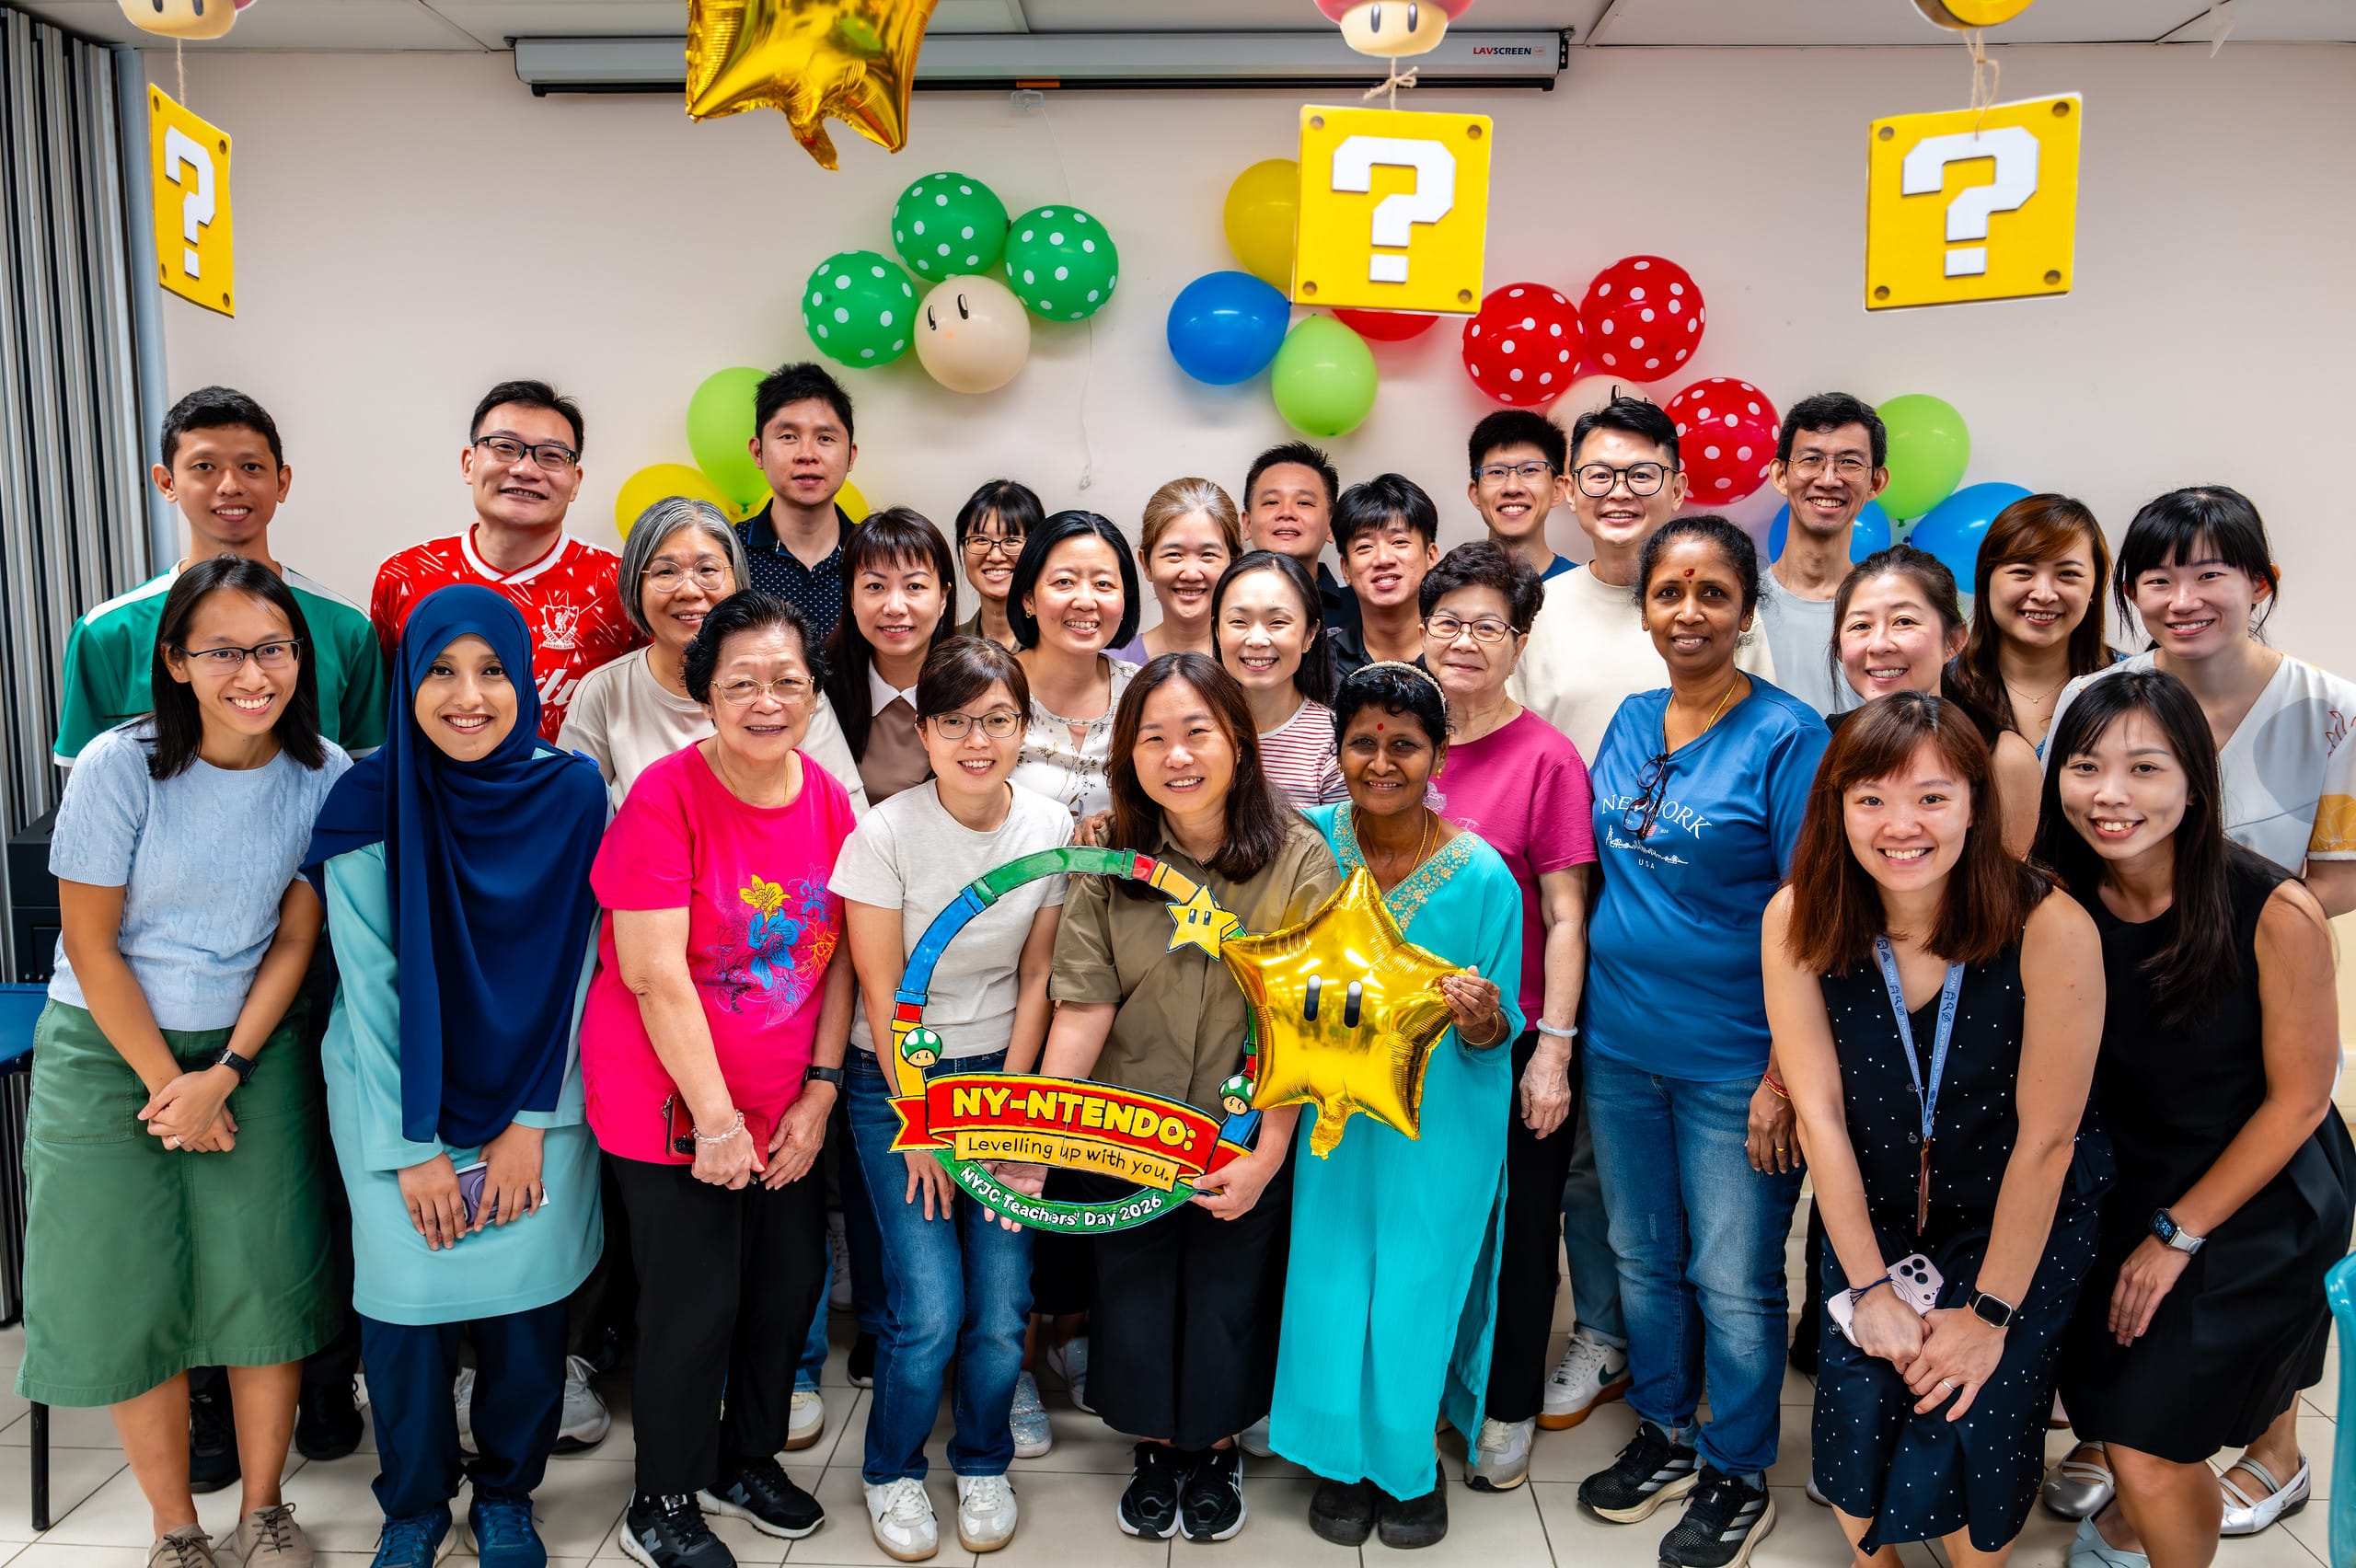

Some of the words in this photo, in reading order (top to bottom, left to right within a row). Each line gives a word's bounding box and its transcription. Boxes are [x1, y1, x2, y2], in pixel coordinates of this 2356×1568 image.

[165, 125, 215, 279] ?
[1332, 135, 1456, 283] ?
[1901, 126, 2039, 277] ?
[1949, 972, 1958, 989] NYJC
[953, 1087, 1196, 1151] NY-NTENDO:
[968, 1136, 1053, 1159] Levelling
[1060, 1146, 1080, 1162] up
[1086, 1147, 1126, 1170] with
[1132, 1160, 1170, 1182] you.
[960, 1167, 1000, 1203] NYJC
[1002, 1194, 1080, 1226] Teachers'
[1084, 1212, 1116, 1227] Day
[1118, 1194, 1162, 1221] 2026
